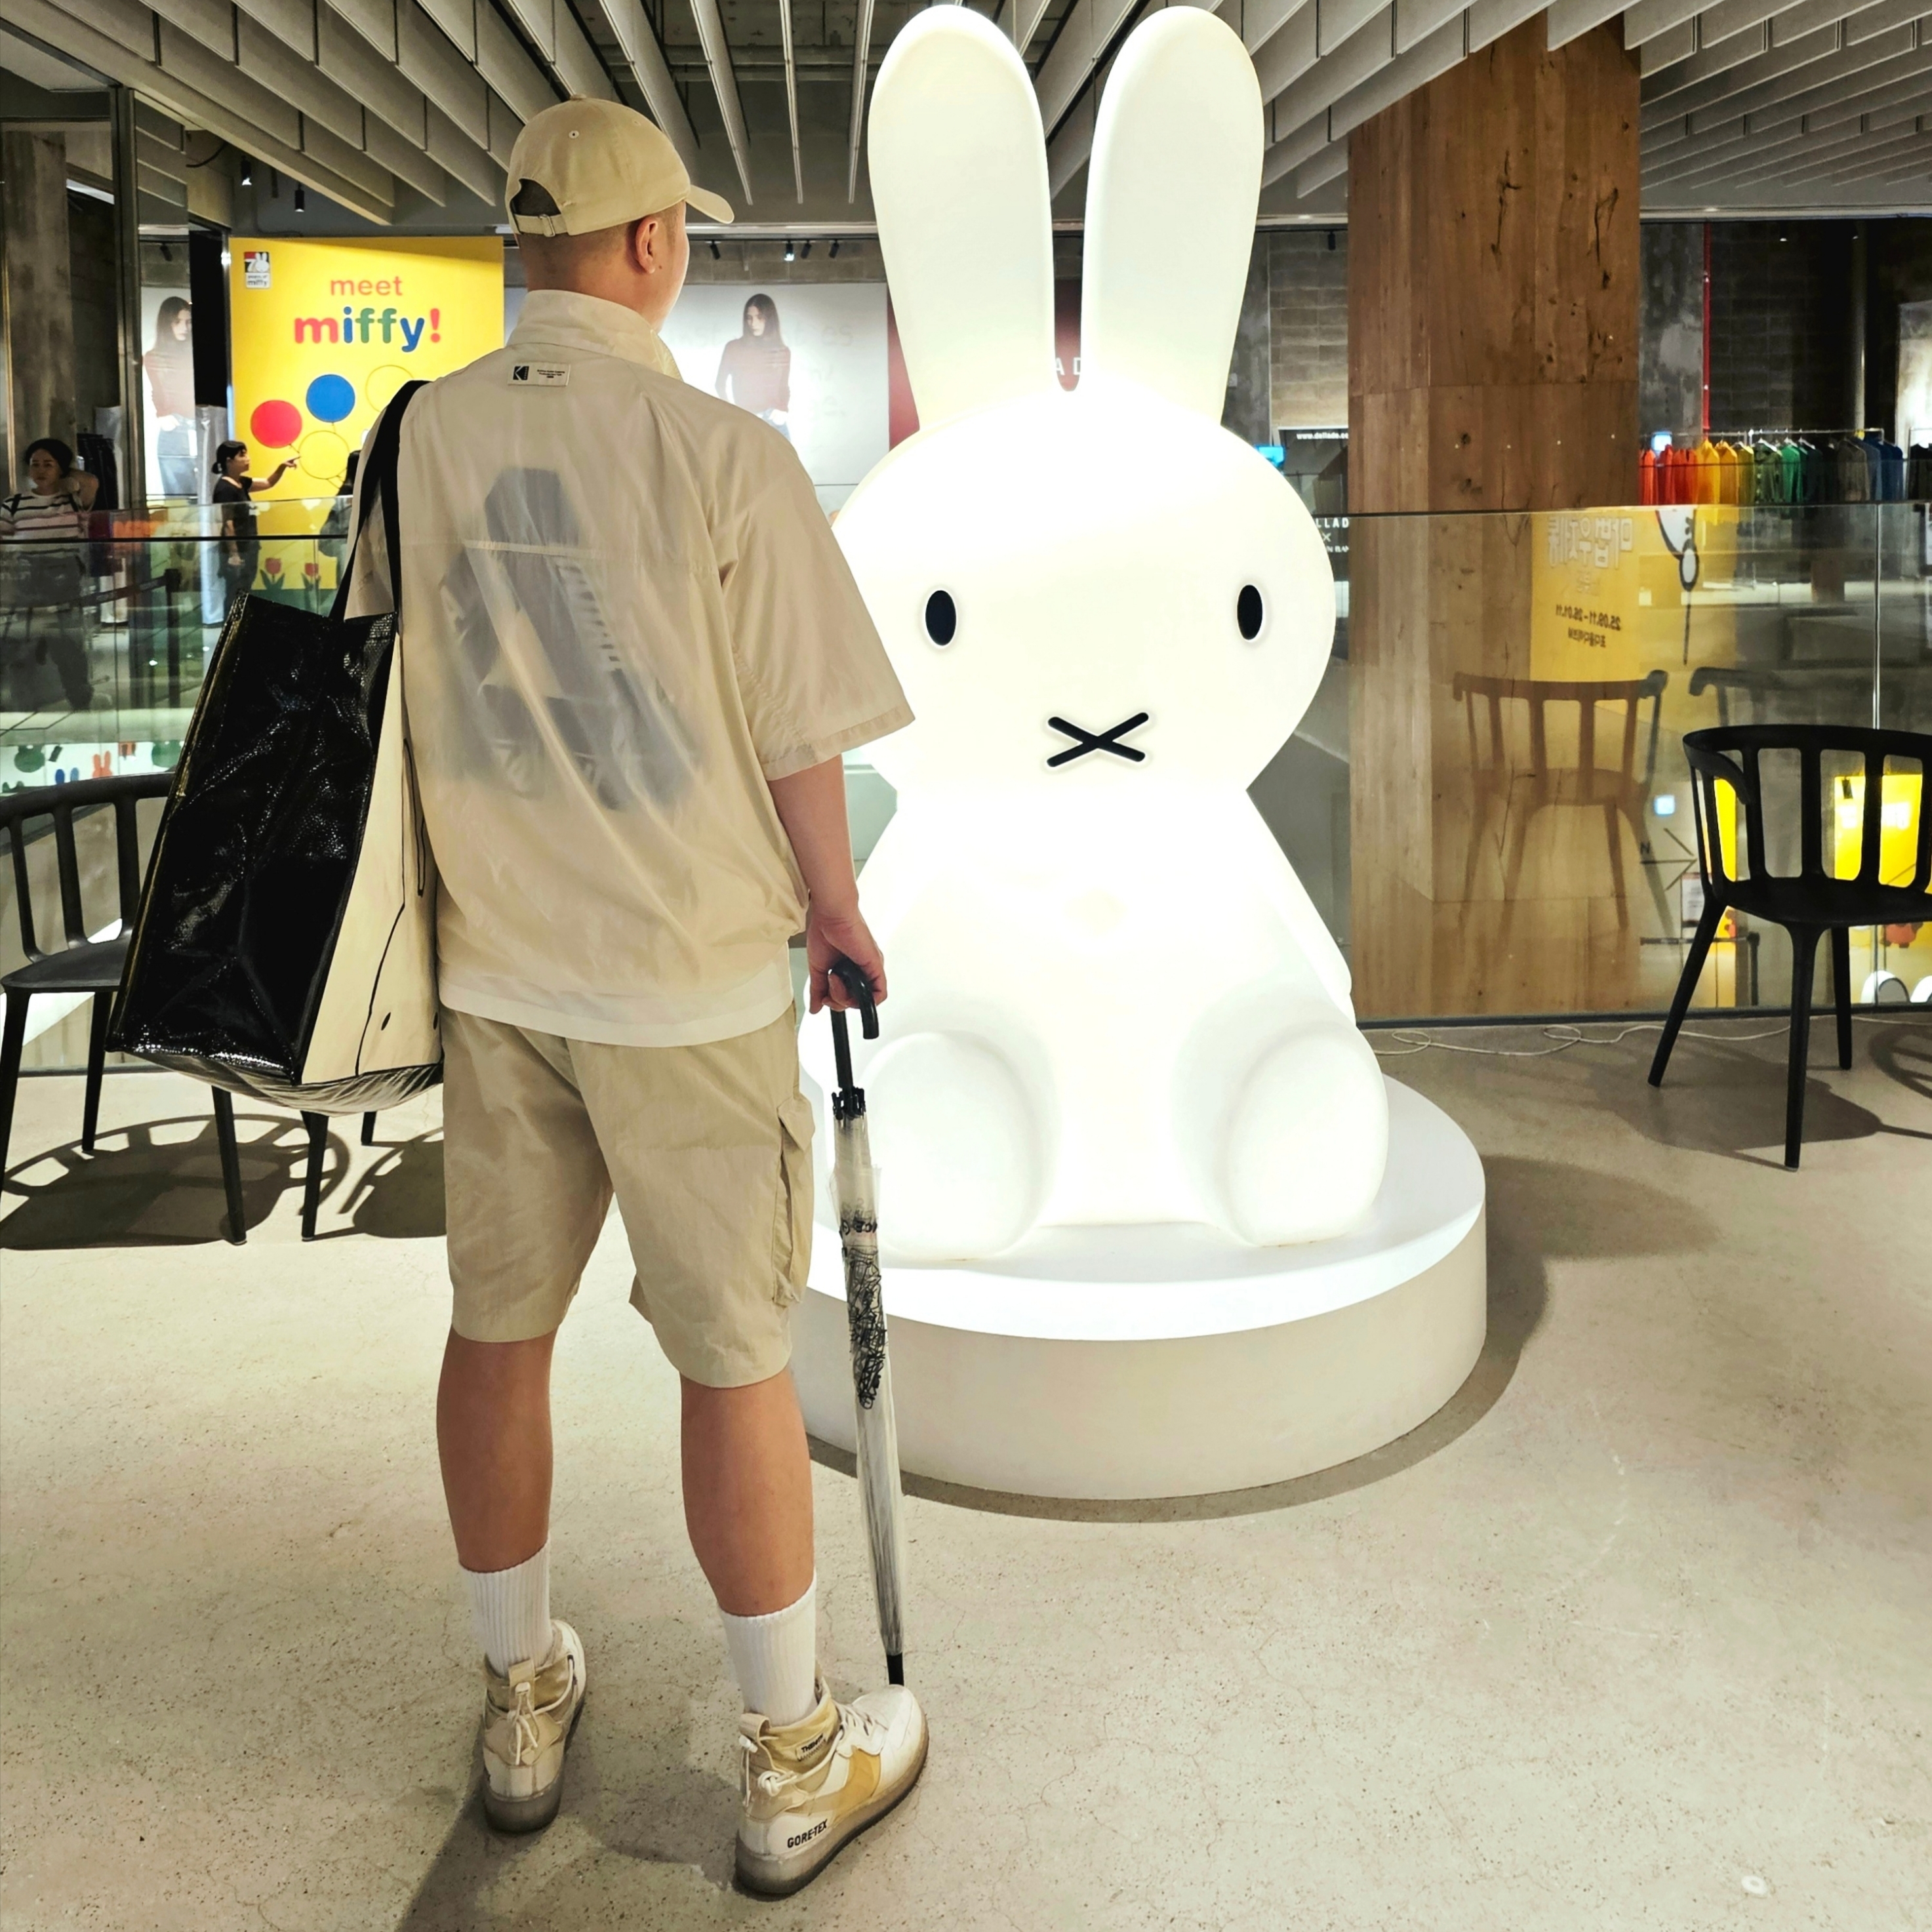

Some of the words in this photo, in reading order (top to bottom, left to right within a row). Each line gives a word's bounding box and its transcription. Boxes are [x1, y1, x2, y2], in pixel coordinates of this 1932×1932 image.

[331, 276, 402, 296] meet
[294, 306, 441, 353] miffy!
[787, 1819, 828, 1849] GORE-TEX
